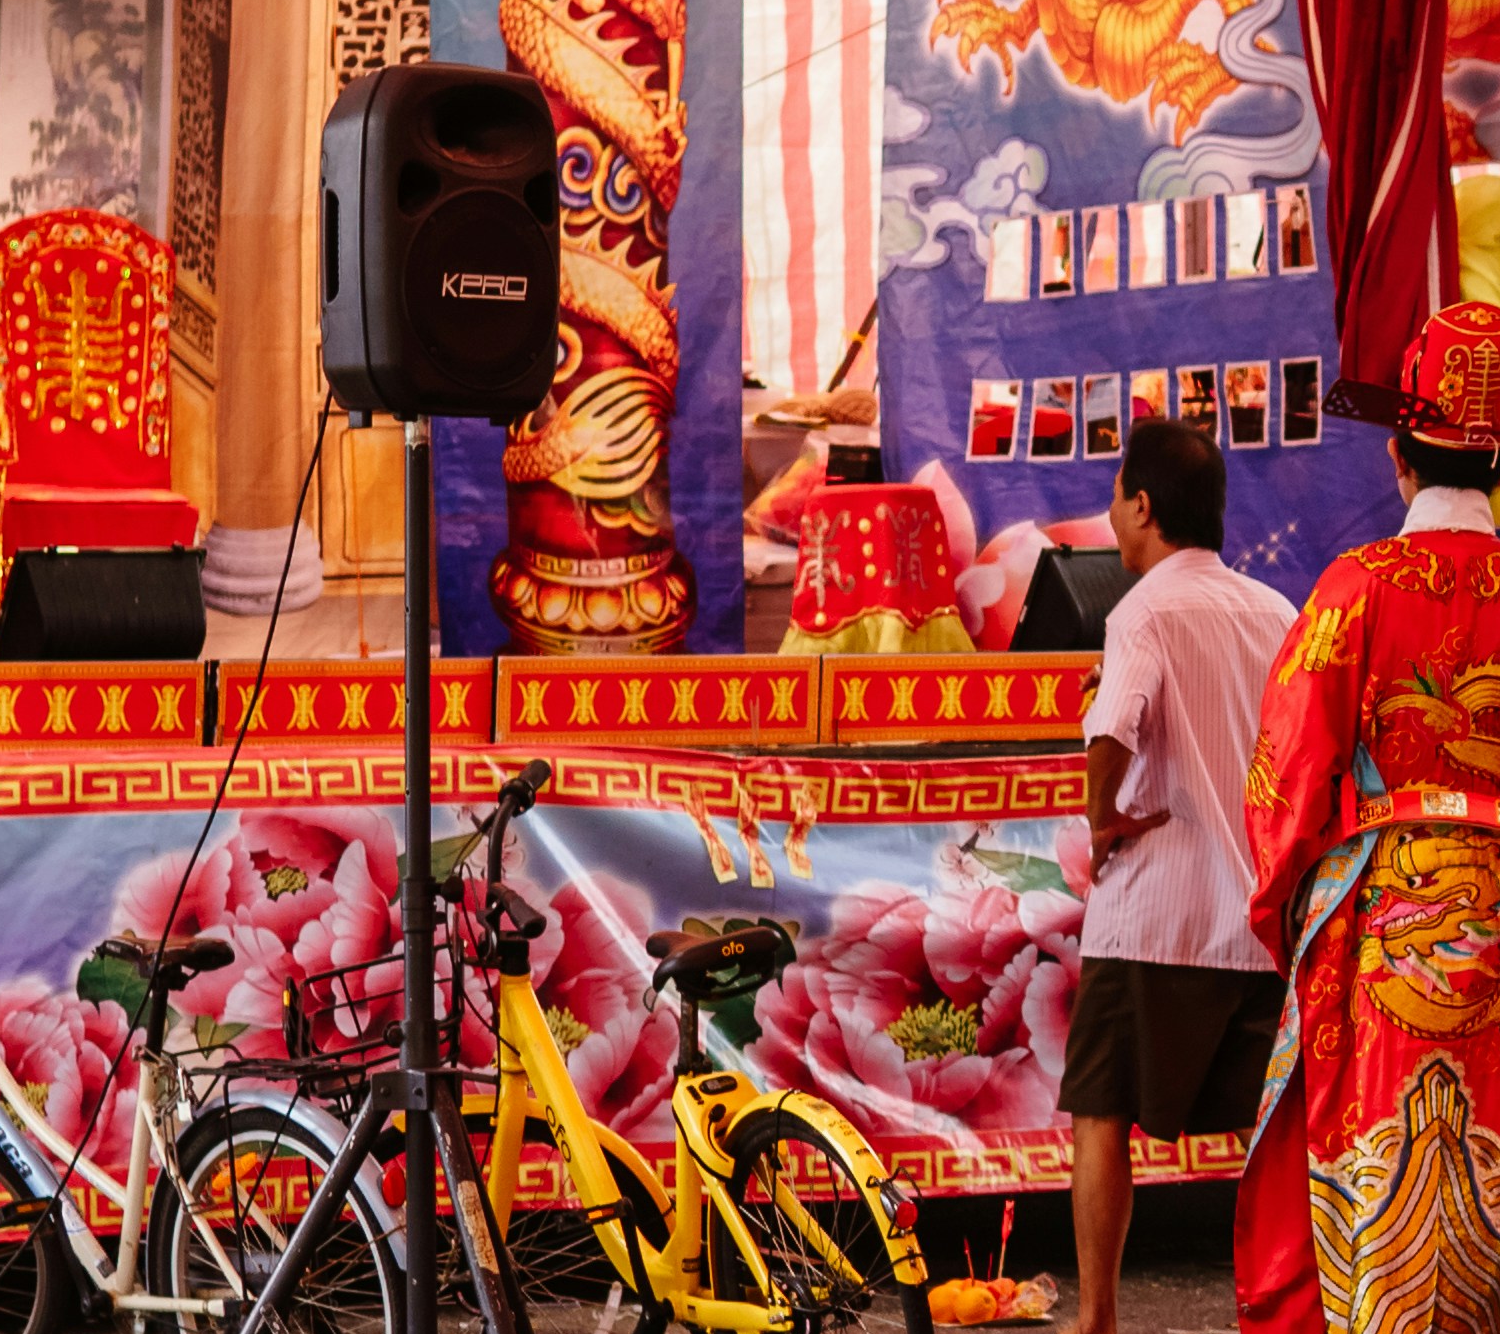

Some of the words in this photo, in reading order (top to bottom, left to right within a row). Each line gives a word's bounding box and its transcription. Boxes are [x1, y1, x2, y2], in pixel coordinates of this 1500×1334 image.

[442, 272, 528, 302] KPRO
[721, 941, 745, 957] ofo
[545, 1105, 572, 1163] ofo
